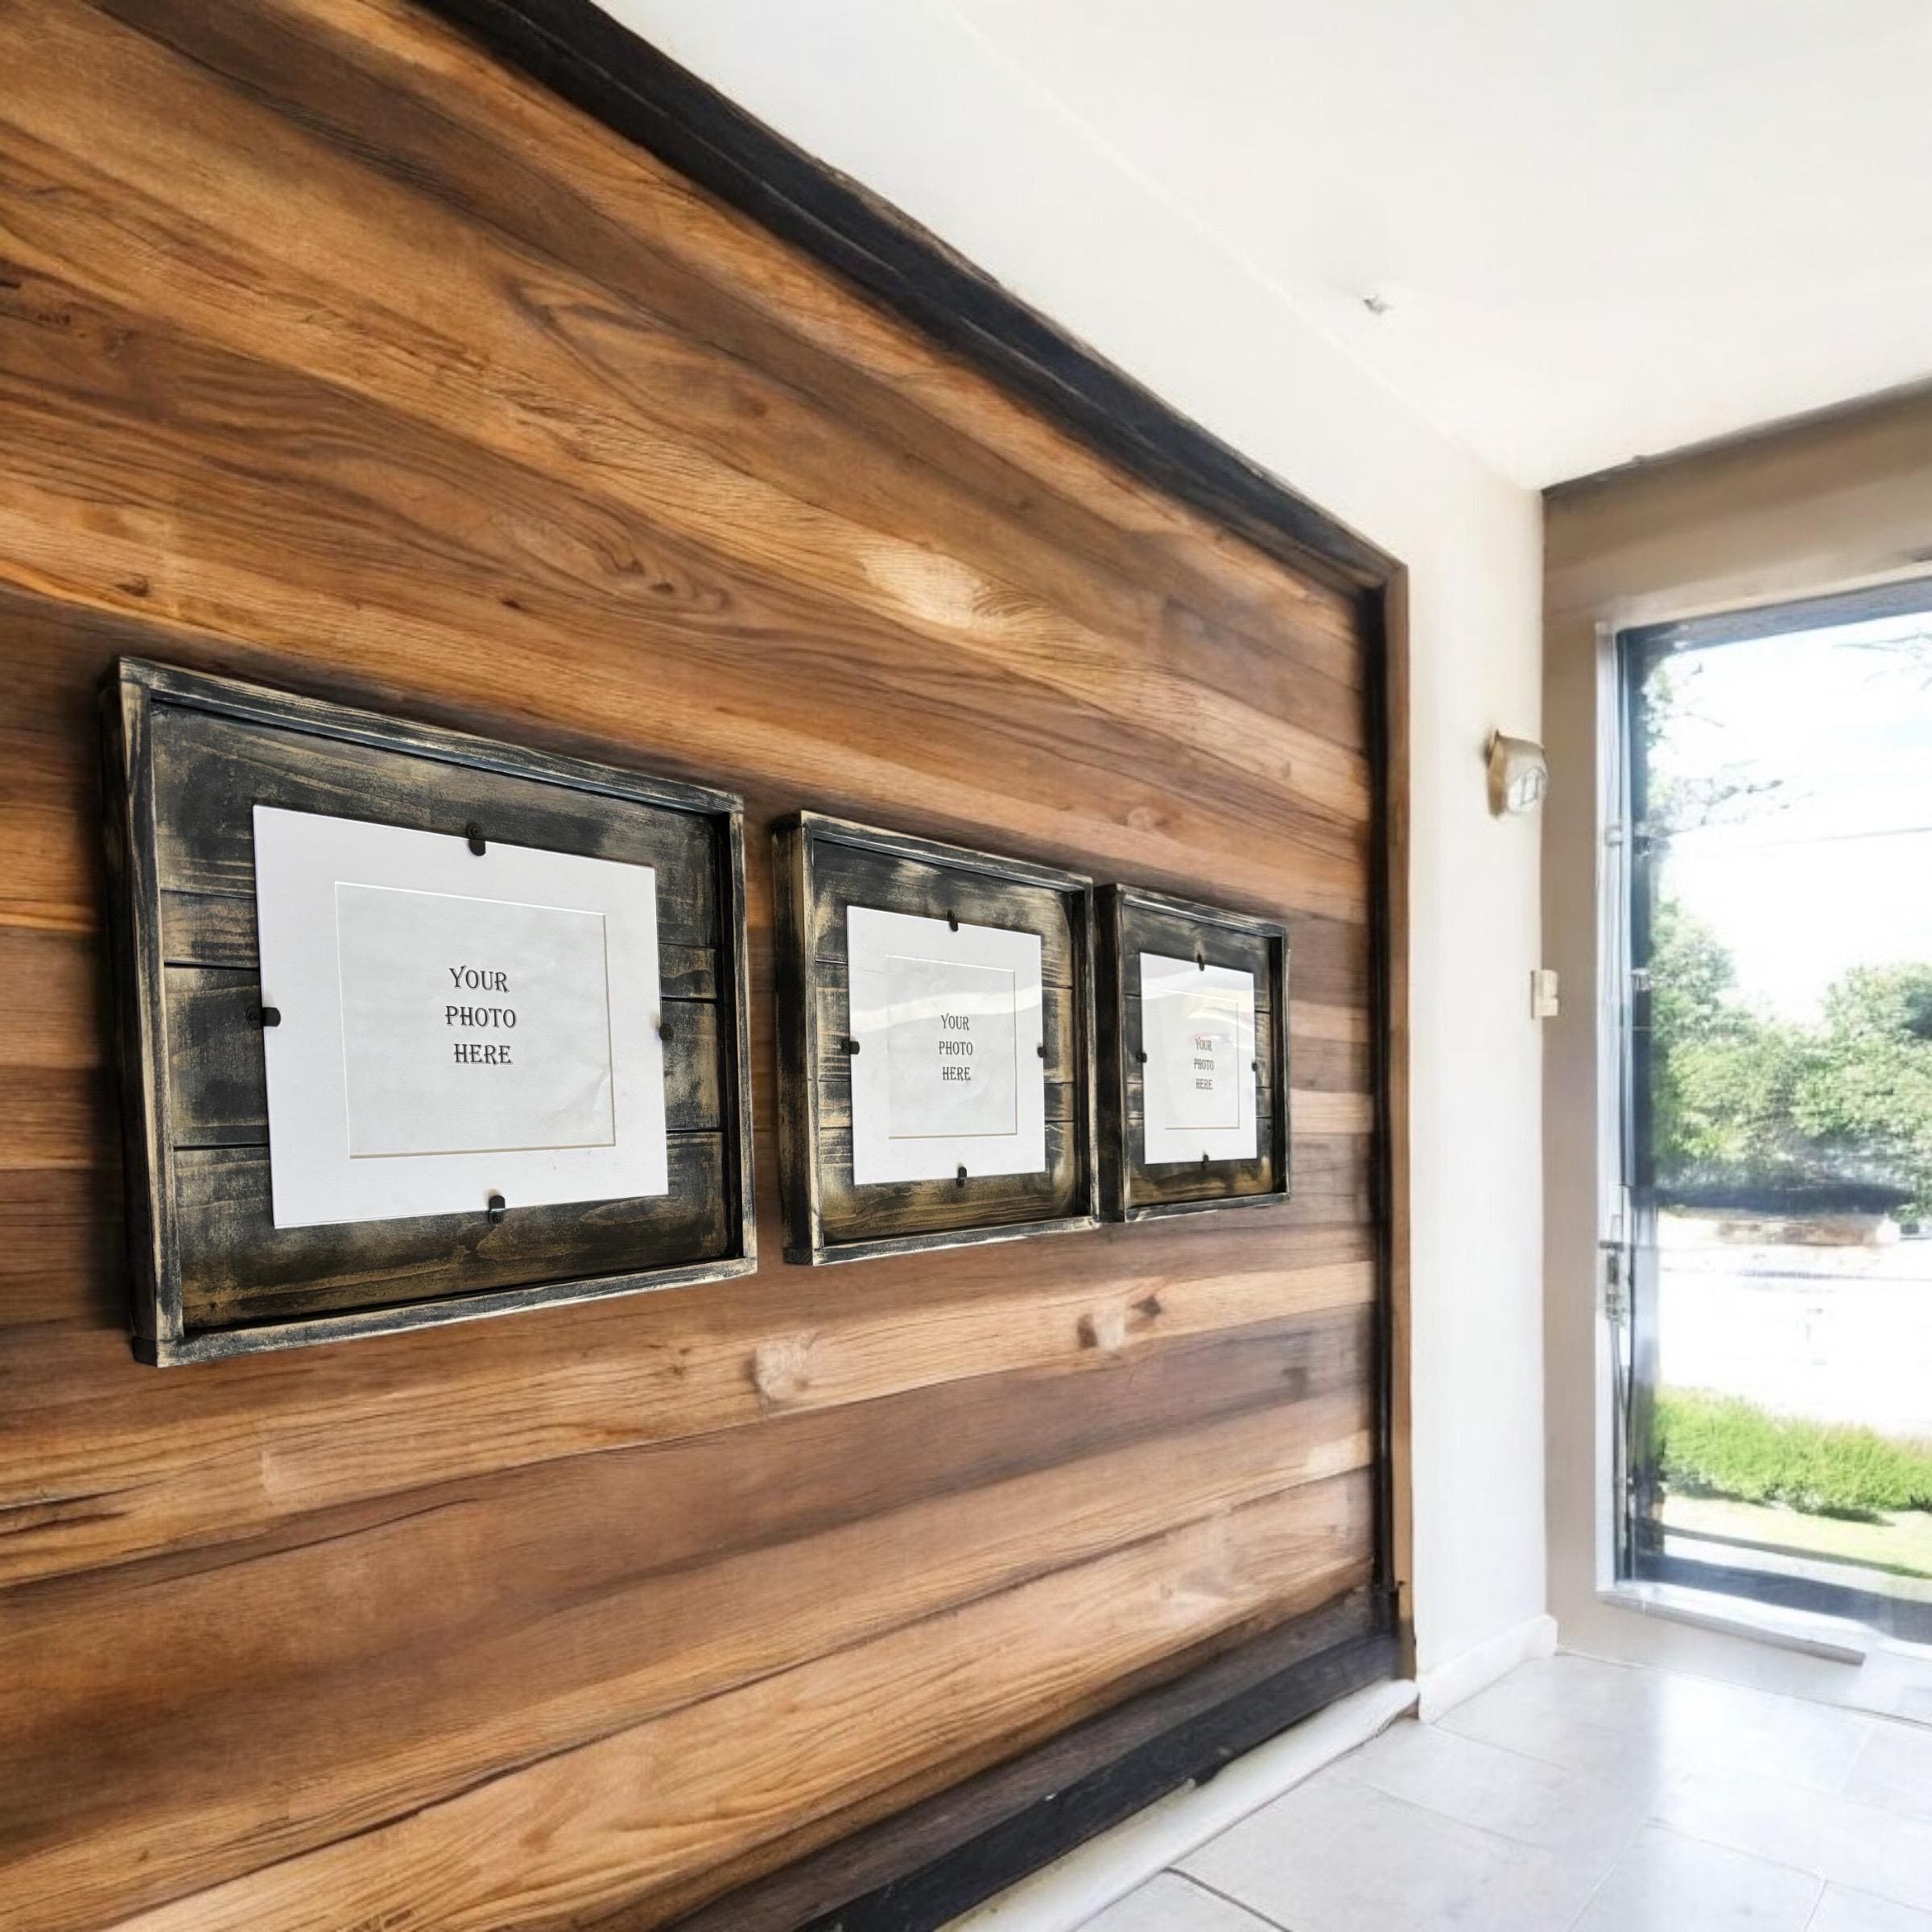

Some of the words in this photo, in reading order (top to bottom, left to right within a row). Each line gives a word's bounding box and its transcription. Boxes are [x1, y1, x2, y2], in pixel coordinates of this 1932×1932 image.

[448, 965, 510, 993] YOUR
[444, 1005, 516, 1028] PHOTO
[940, 1013, 970, 1030] YOUR
[939, 1041, 973, 1055] PHOTO
[1195, 1037, 1212, 1051] YOUR
[453, 1043, 514, 1065] HERE
[1194, 1058, 1214, 1071] PHOTO
[942, 1067, 972, 1081] HERE
[1195, 1078, 1213, 1090] HERE
